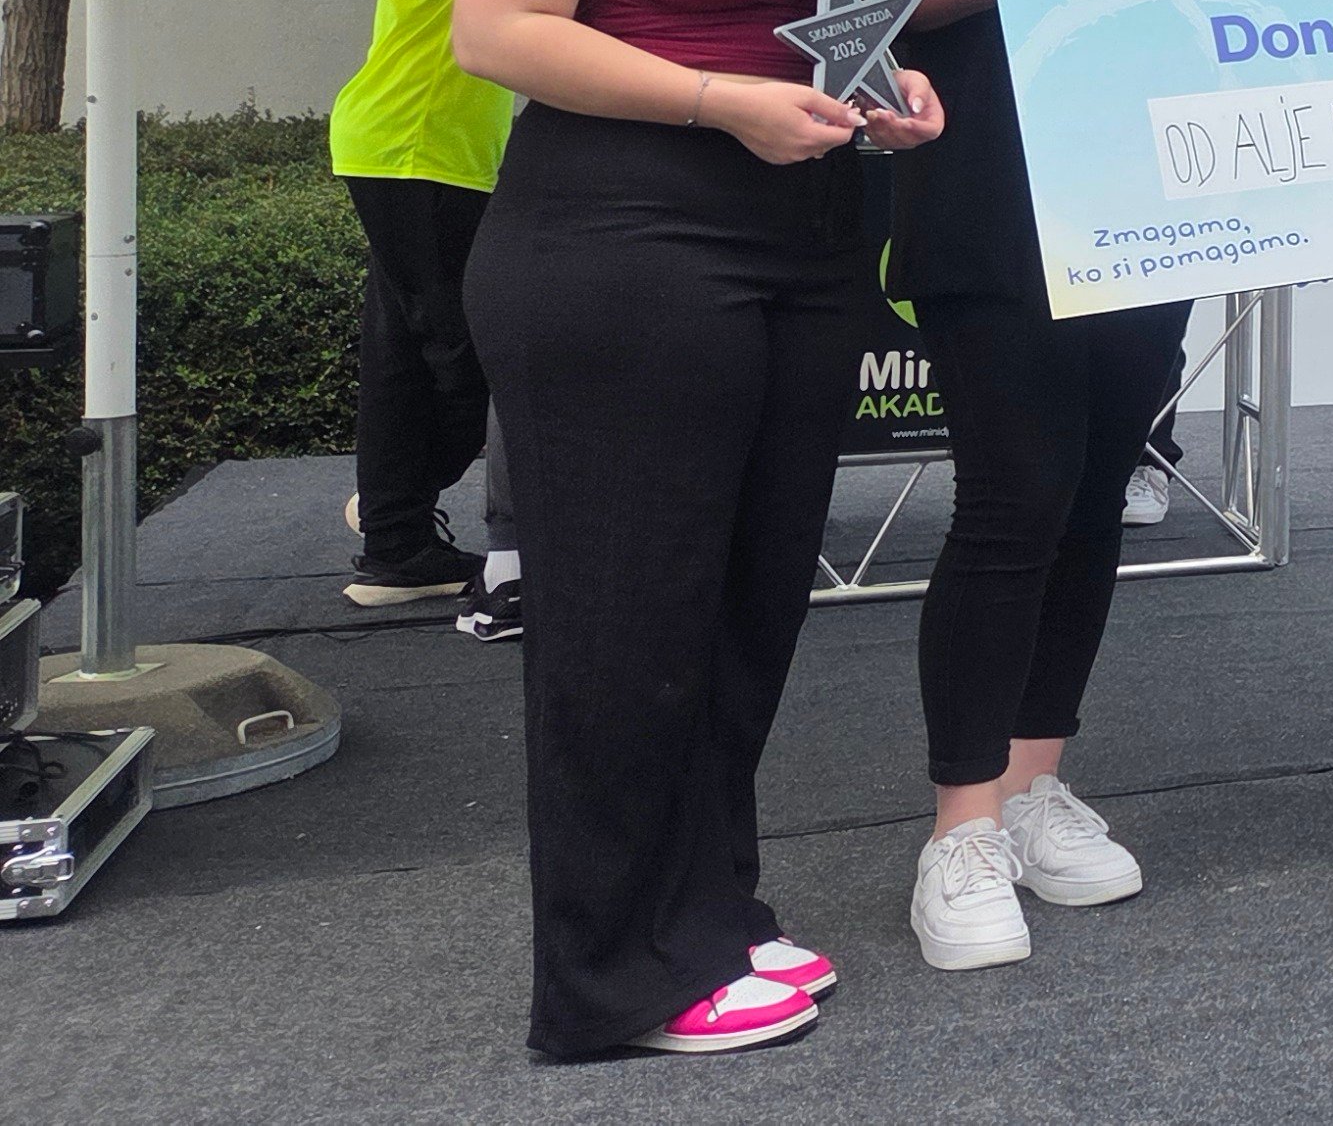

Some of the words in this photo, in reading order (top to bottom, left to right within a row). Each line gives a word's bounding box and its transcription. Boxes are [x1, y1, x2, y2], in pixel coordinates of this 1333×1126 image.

[808, 20, 854, 42] SKAZINA
[853, 8, 894, 29] ZVEZDA
[829, 38, 867, 61] 2026
[1165, 123, 1216, 187] OD
[1094, 217, 1250, 247] Zmagamo,
[1067, 267, 1101, 285] ko
[1113, 258, 1131, 279] si
[1140, 231, 1309, 278] pomagamo.
